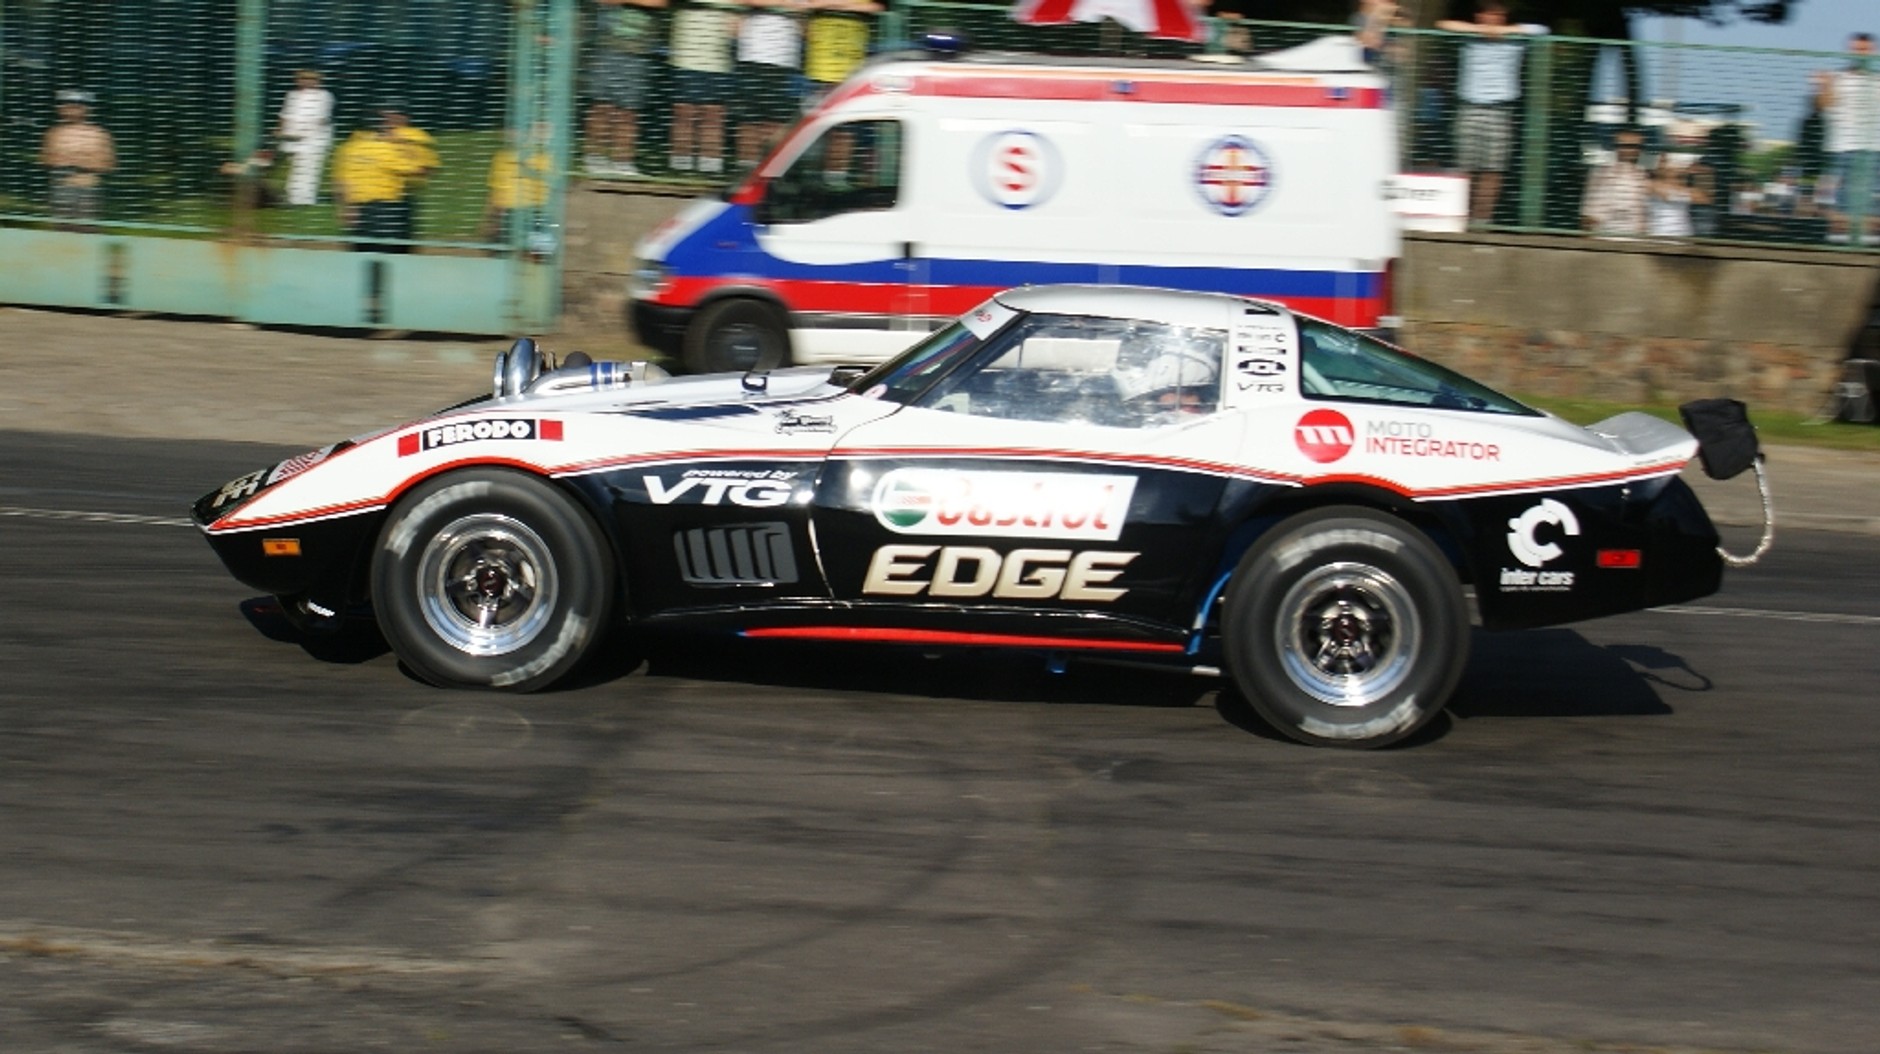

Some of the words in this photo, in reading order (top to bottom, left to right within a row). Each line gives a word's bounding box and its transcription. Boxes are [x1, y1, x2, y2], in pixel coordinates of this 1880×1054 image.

[427, 420, 531, 448] FERODO
[1366, 420, 1432, 438] MOTO
[1366, 437, 1500, 461] INTEGRATOR
[681, 469, 771, 479] powered
[772, 469, 798, 481] by
[643, 475, 793, 507] VTG
[861, 543, 1142, 602] EDGE
[1500, 568, 1538, 585] inter
[1538, 570, 1575, 585] cars
